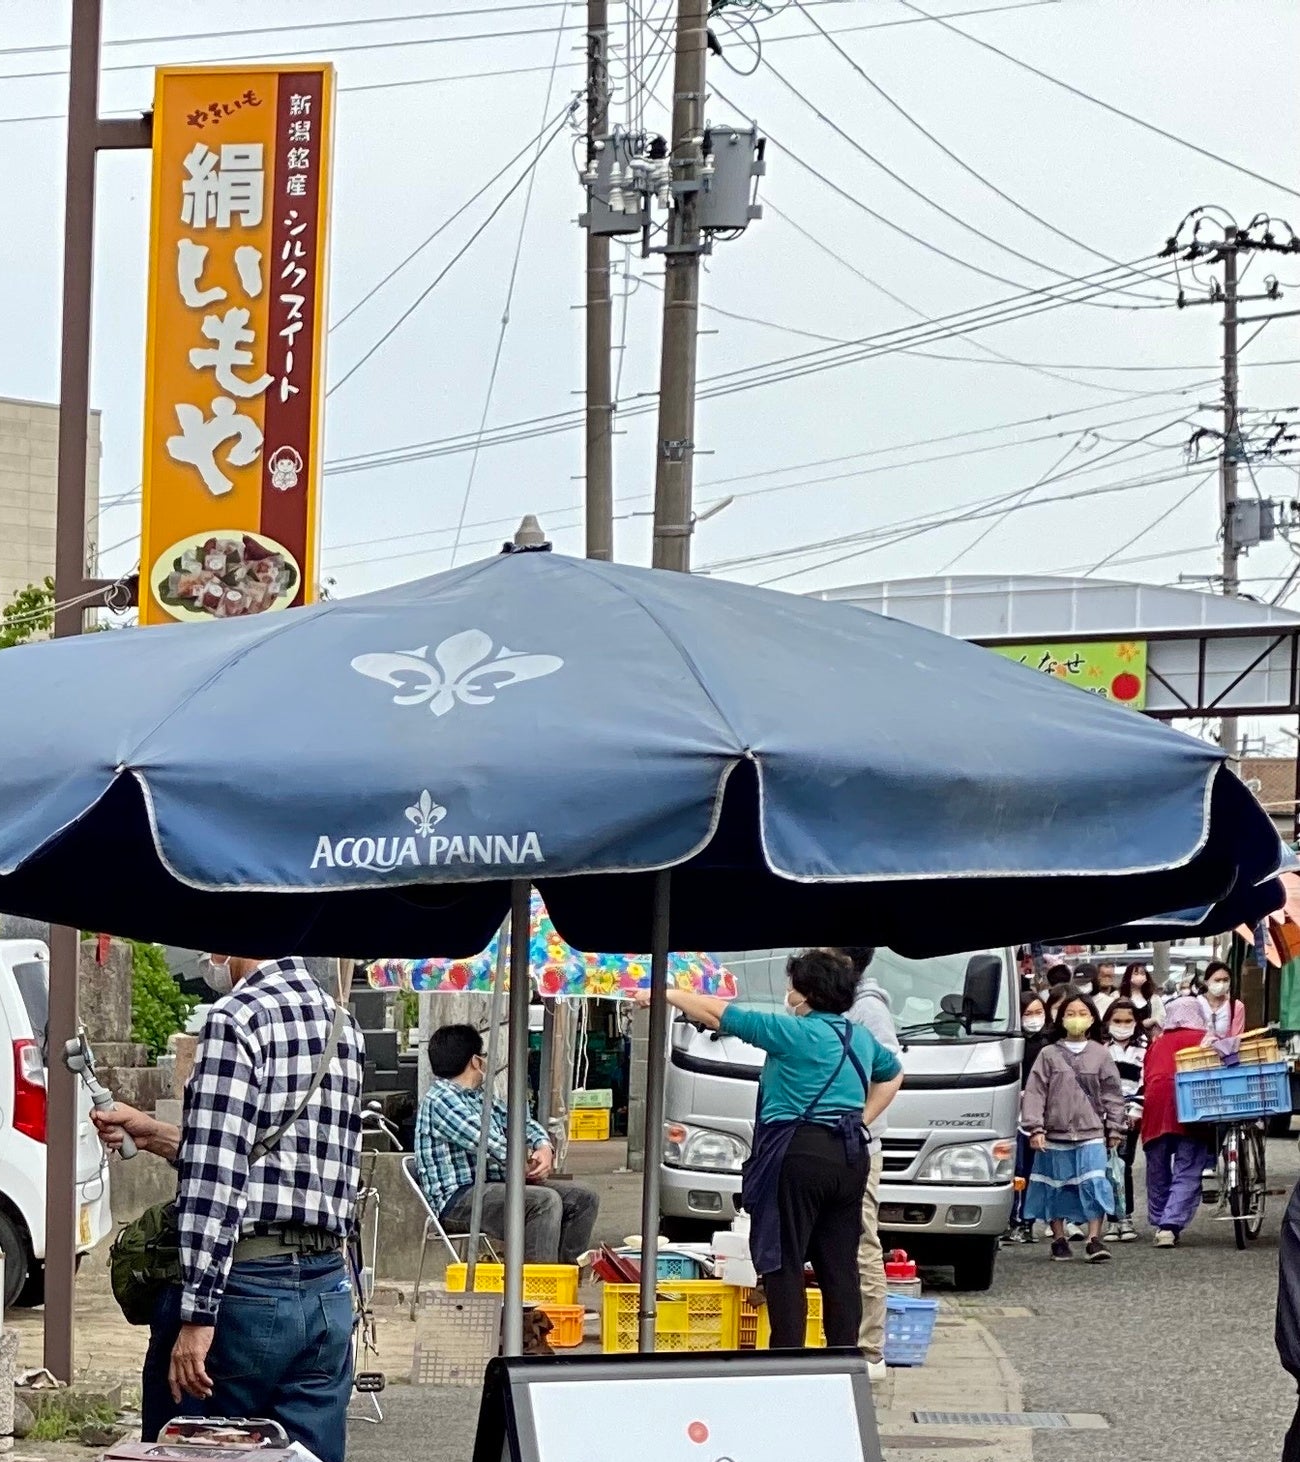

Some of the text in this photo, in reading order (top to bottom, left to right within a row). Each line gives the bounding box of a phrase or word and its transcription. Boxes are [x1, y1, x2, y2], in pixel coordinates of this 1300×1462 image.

[186, 90, 263, 129] やきいも
[166, 142, 275, 496] 絹いもや
[279, 93, 313, 403] 新潟銘産 シルクスイート
[310, 831, 546, 873] ACQUA PANNA
